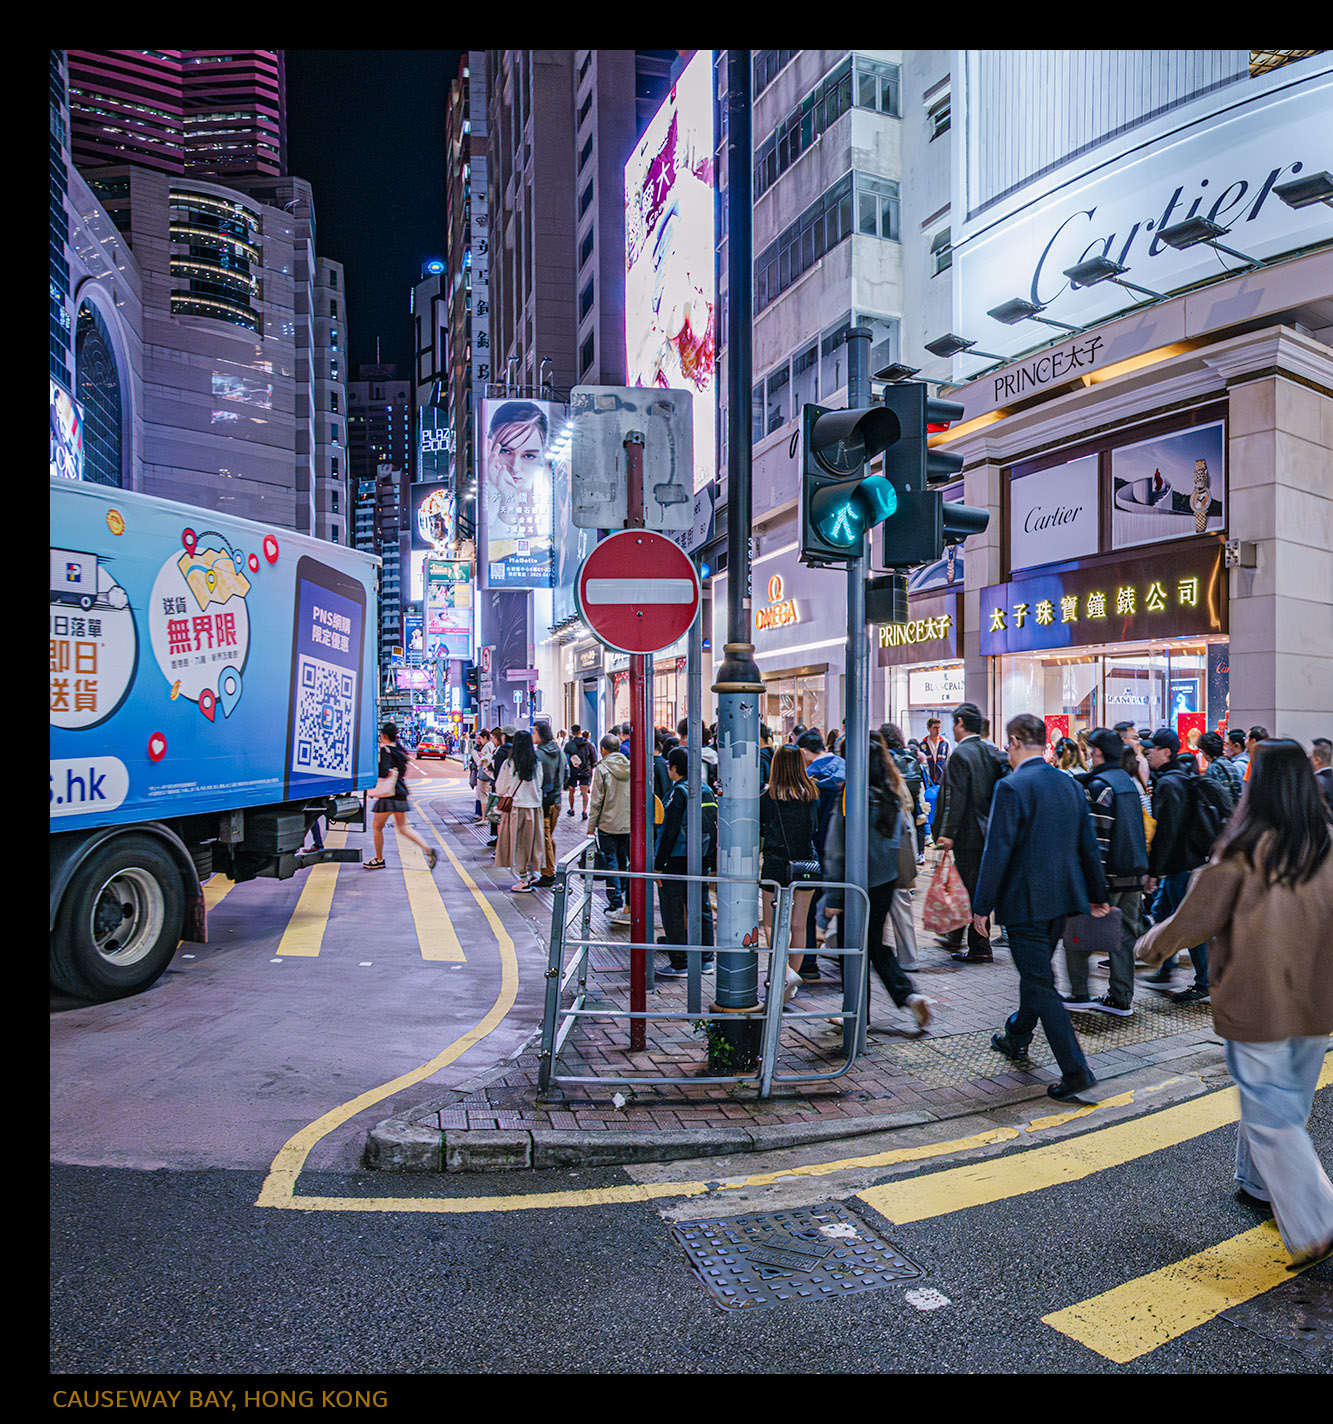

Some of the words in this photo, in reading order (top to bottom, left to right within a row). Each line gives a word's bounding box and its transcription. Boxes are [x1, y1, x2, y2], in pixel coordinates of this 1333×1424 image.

[1030, 161, 1303, 305] Cartier
[994, 336, 1104, 402] PRINCE太子
[422, 440, 449, 452] 200
[423, 428, 449, 442] PLAZ
[1024, 506, 1083, 534] Cartier
[163, 597, 187, 615] 送貨
[755, 600, 797, 630] OMEGA
[989, 577, 1199, 632] 太子珠寶鐘錶公司
[50, 614, 102, 638] 日落單
[167, 612, 238, 655] 無界限
[879, 614, 950, 648] PRINCE太子
